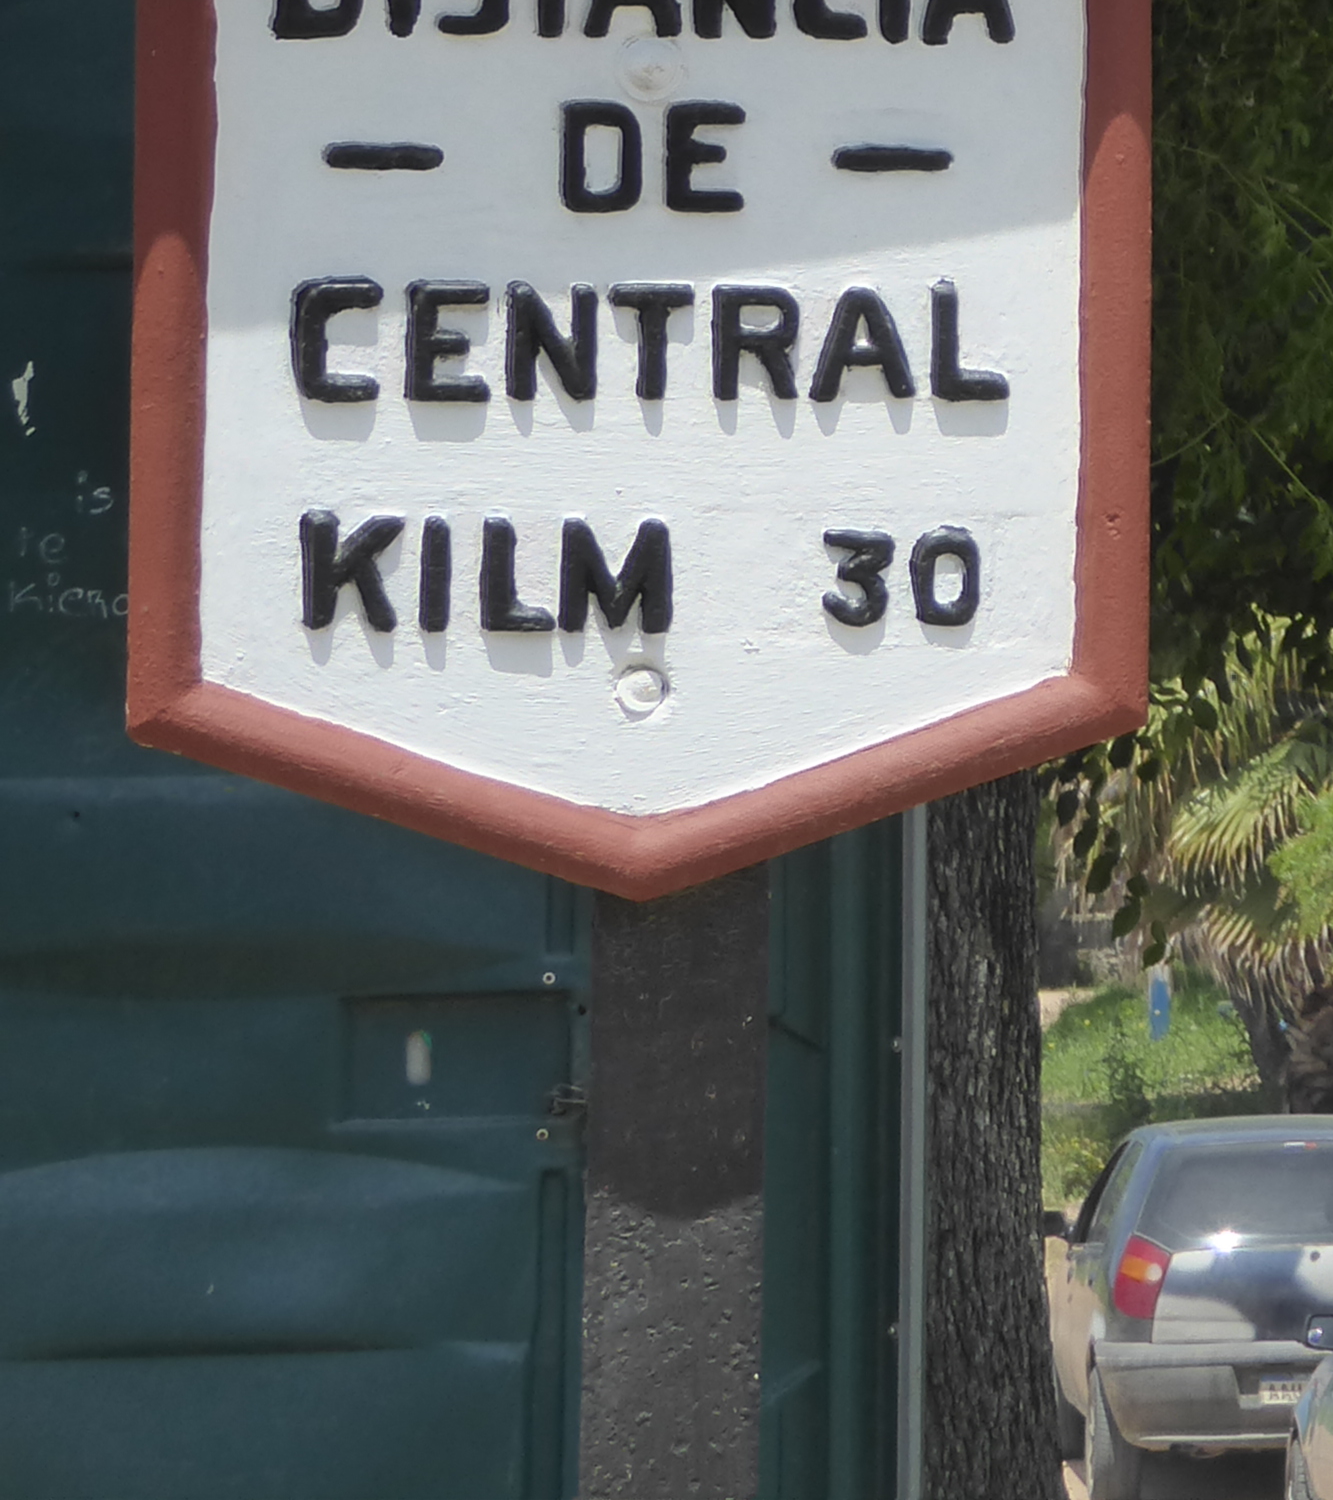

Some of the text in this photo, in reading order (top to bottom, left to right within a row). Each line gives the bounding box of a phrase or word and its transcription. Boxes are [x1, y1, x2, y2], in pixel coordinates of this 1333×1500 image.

[560, 100, 746, 213] DE
[289, 276, 1011, 404] CENTRAL
[299, 509, 982, 634] KILM 30
